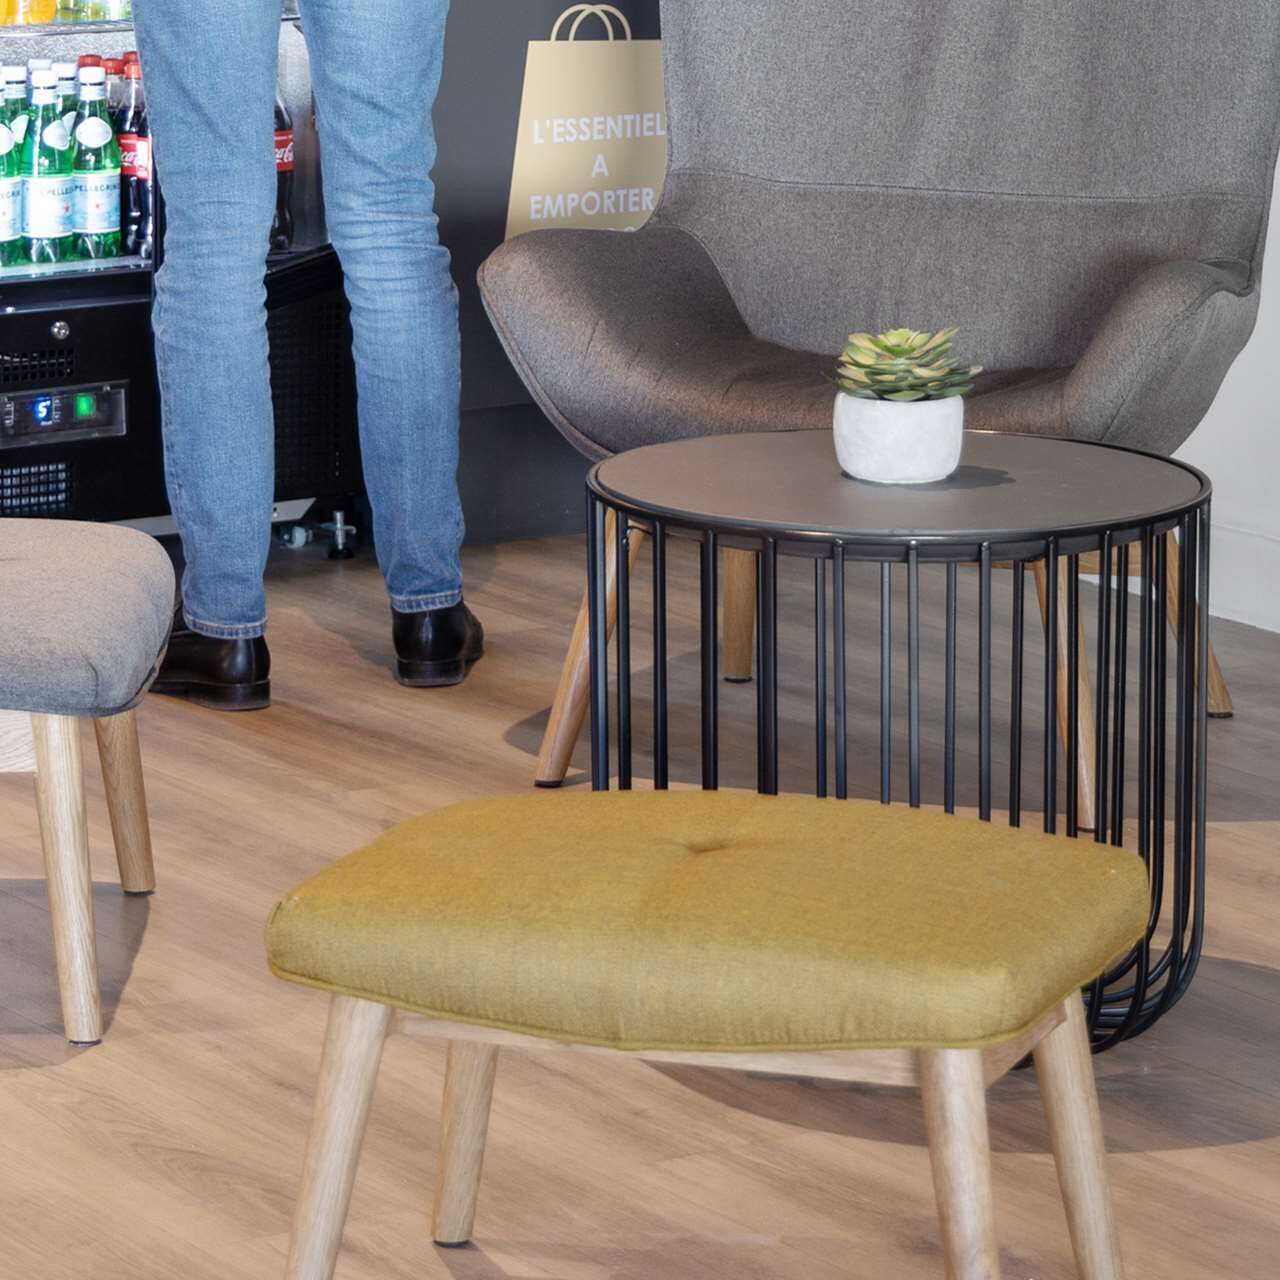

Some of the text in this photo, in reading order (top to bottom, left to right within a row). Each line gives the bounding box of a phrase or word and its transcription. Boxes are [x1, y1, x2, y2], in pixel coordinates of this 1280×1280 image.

[532, 112, 666, 145] L'ESSENTIEL
[591, 153, 609, 178] A
[529, 187, 656, 220] EMPORTER
